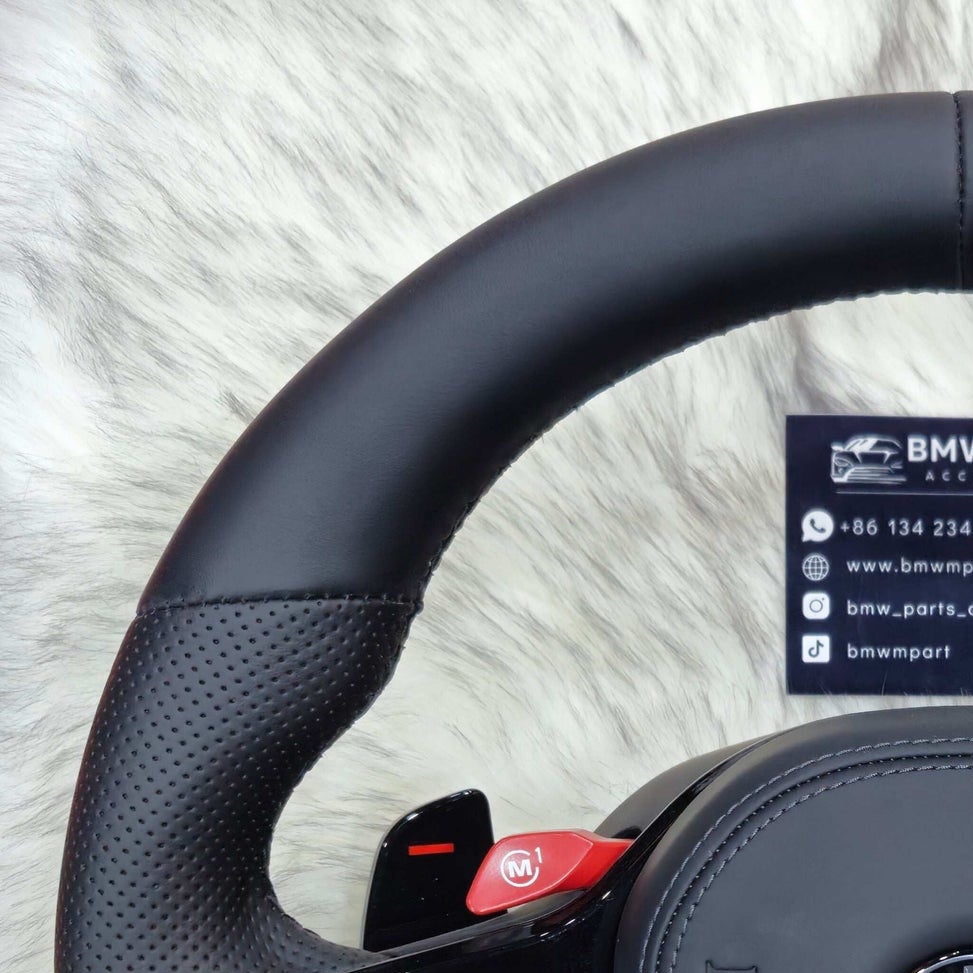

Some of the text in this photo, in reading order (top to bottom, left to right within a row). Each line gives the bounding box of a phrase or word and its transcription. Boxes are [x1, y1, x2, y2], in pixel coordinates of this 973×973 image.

[840, 520, 878, 536] +86
[888, 520, 924, 536] 134
[847, 644, 950, 662] bmwmpart
